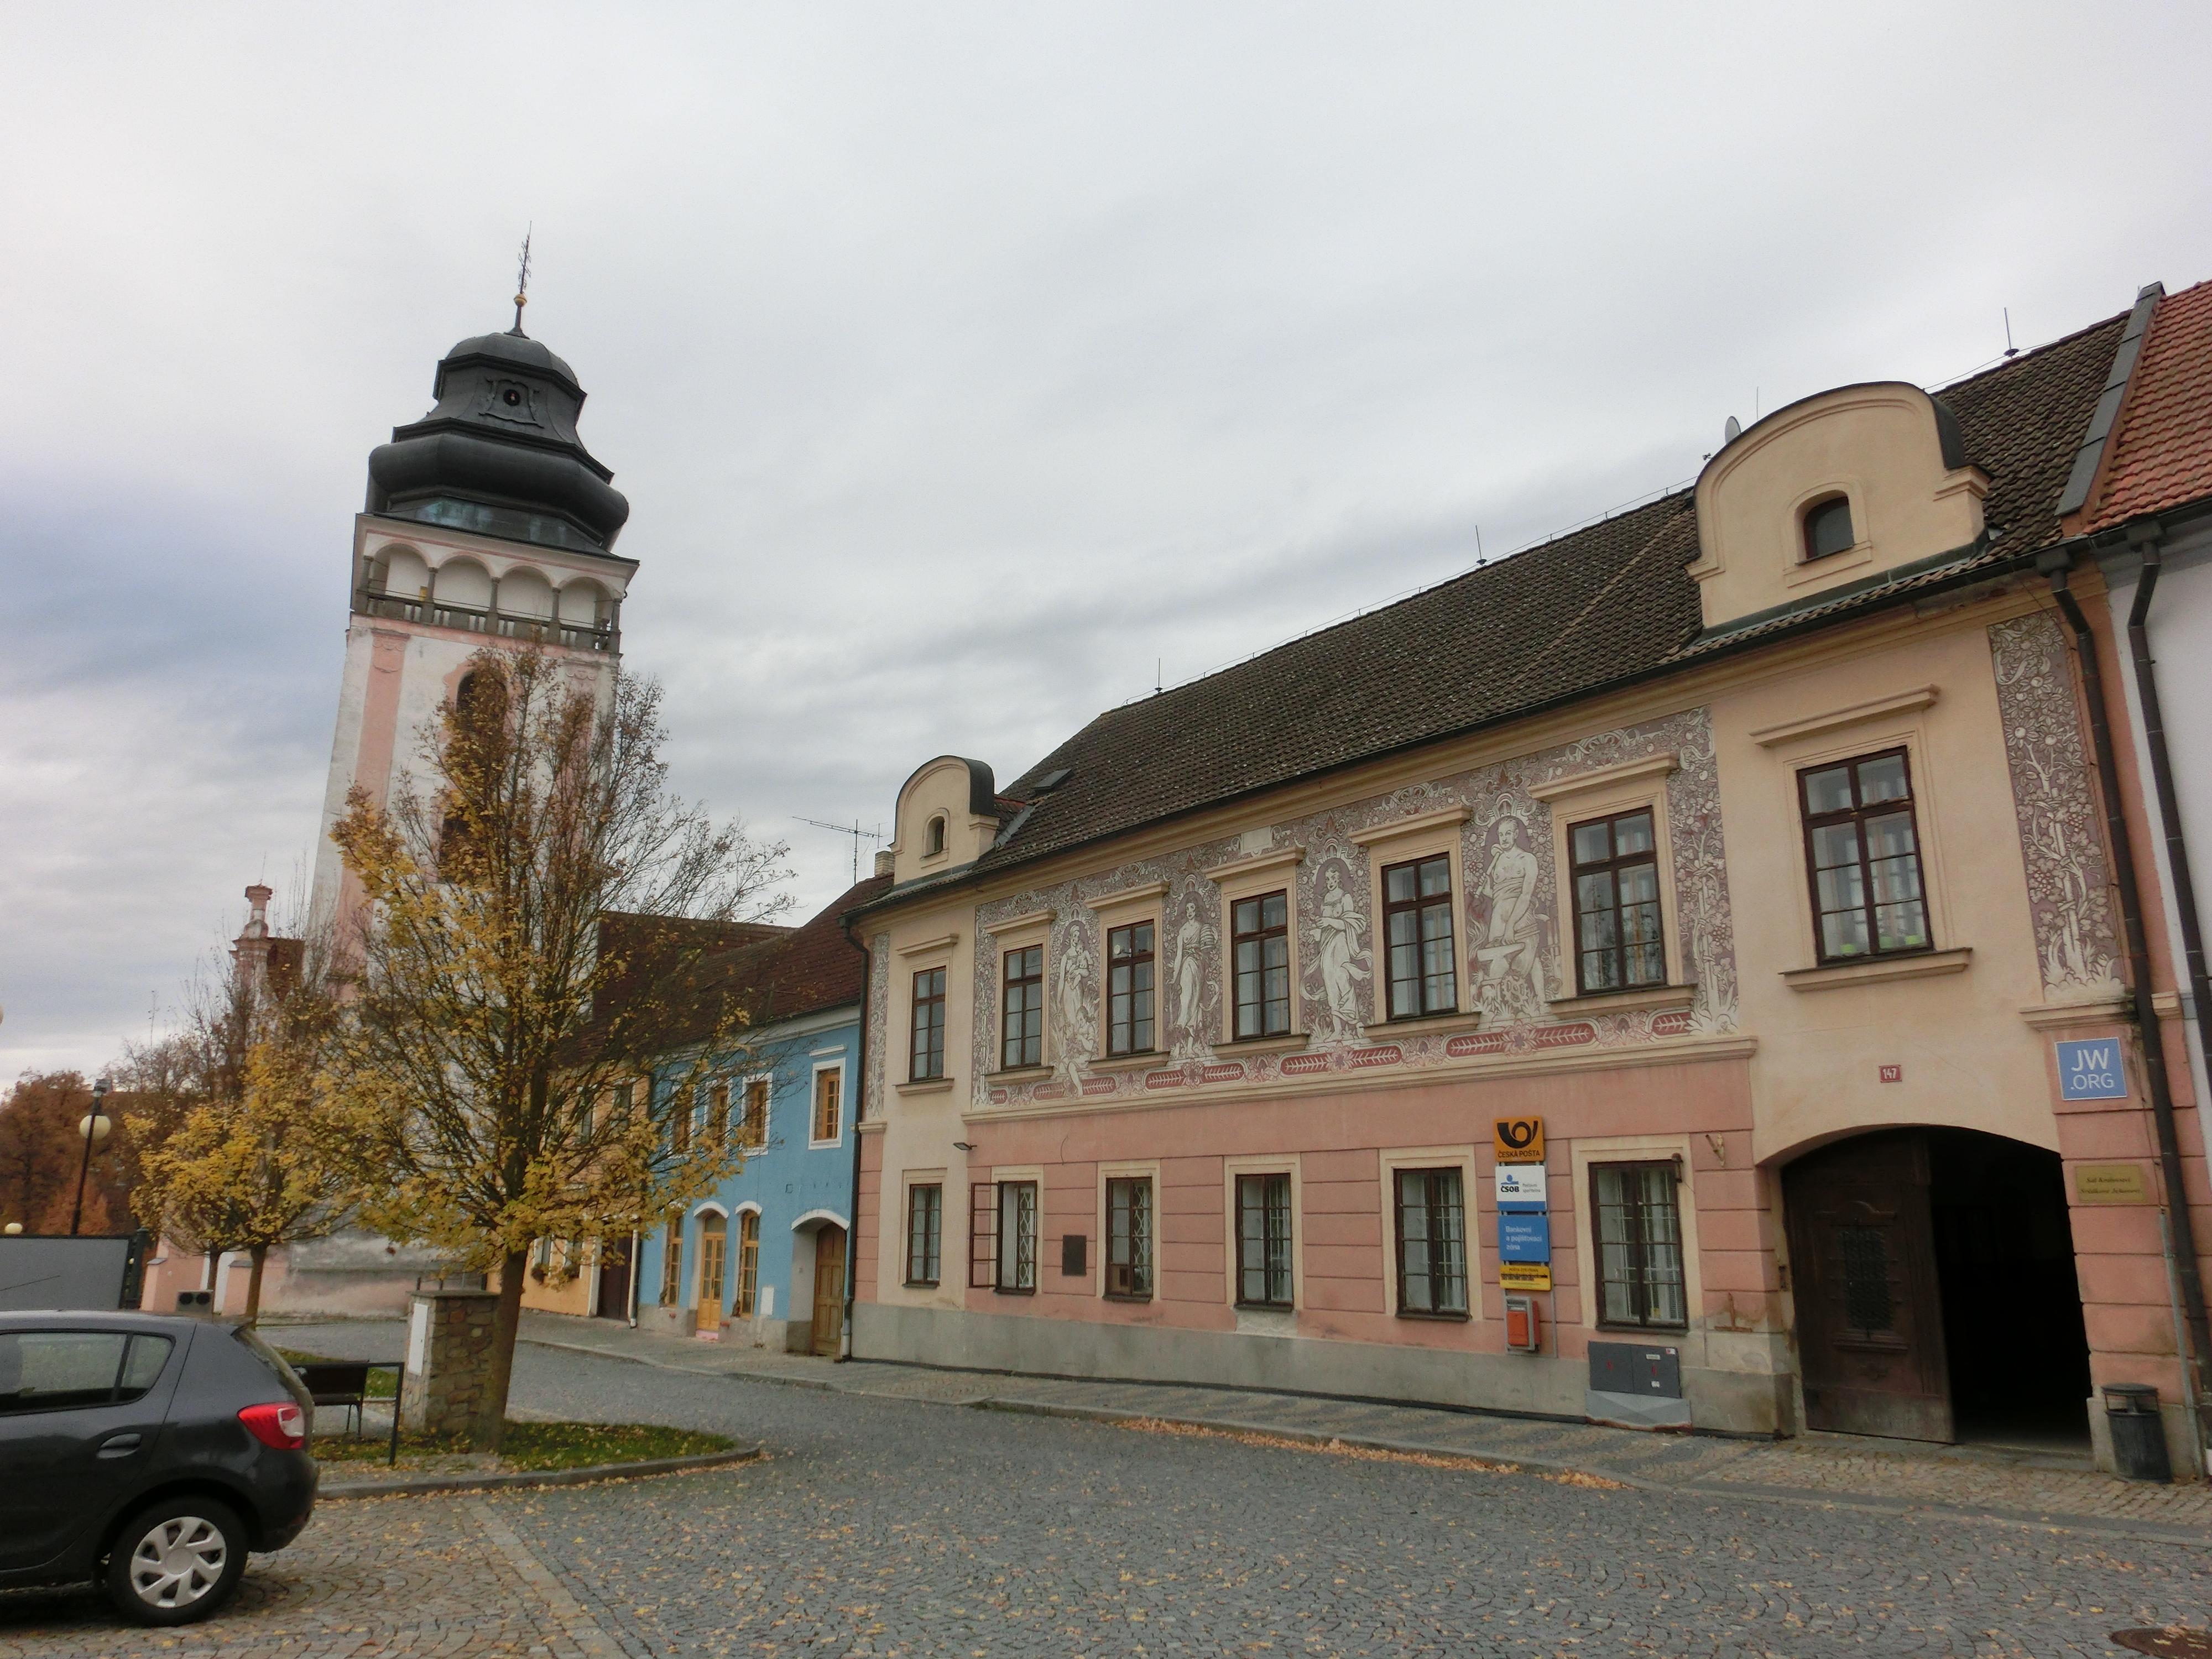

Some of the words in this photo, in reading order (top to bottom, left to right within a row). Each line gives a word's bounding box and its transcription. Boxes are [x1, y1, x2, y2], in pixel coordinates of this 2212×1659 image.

[2070, 1047, 2109, 1071] JW
[1882, 1068, 1897, 1079] 147
[2070, 1073, 2115, 1089] .ORG
[1498, 1150, 1518, 1158] ČESKÁ
